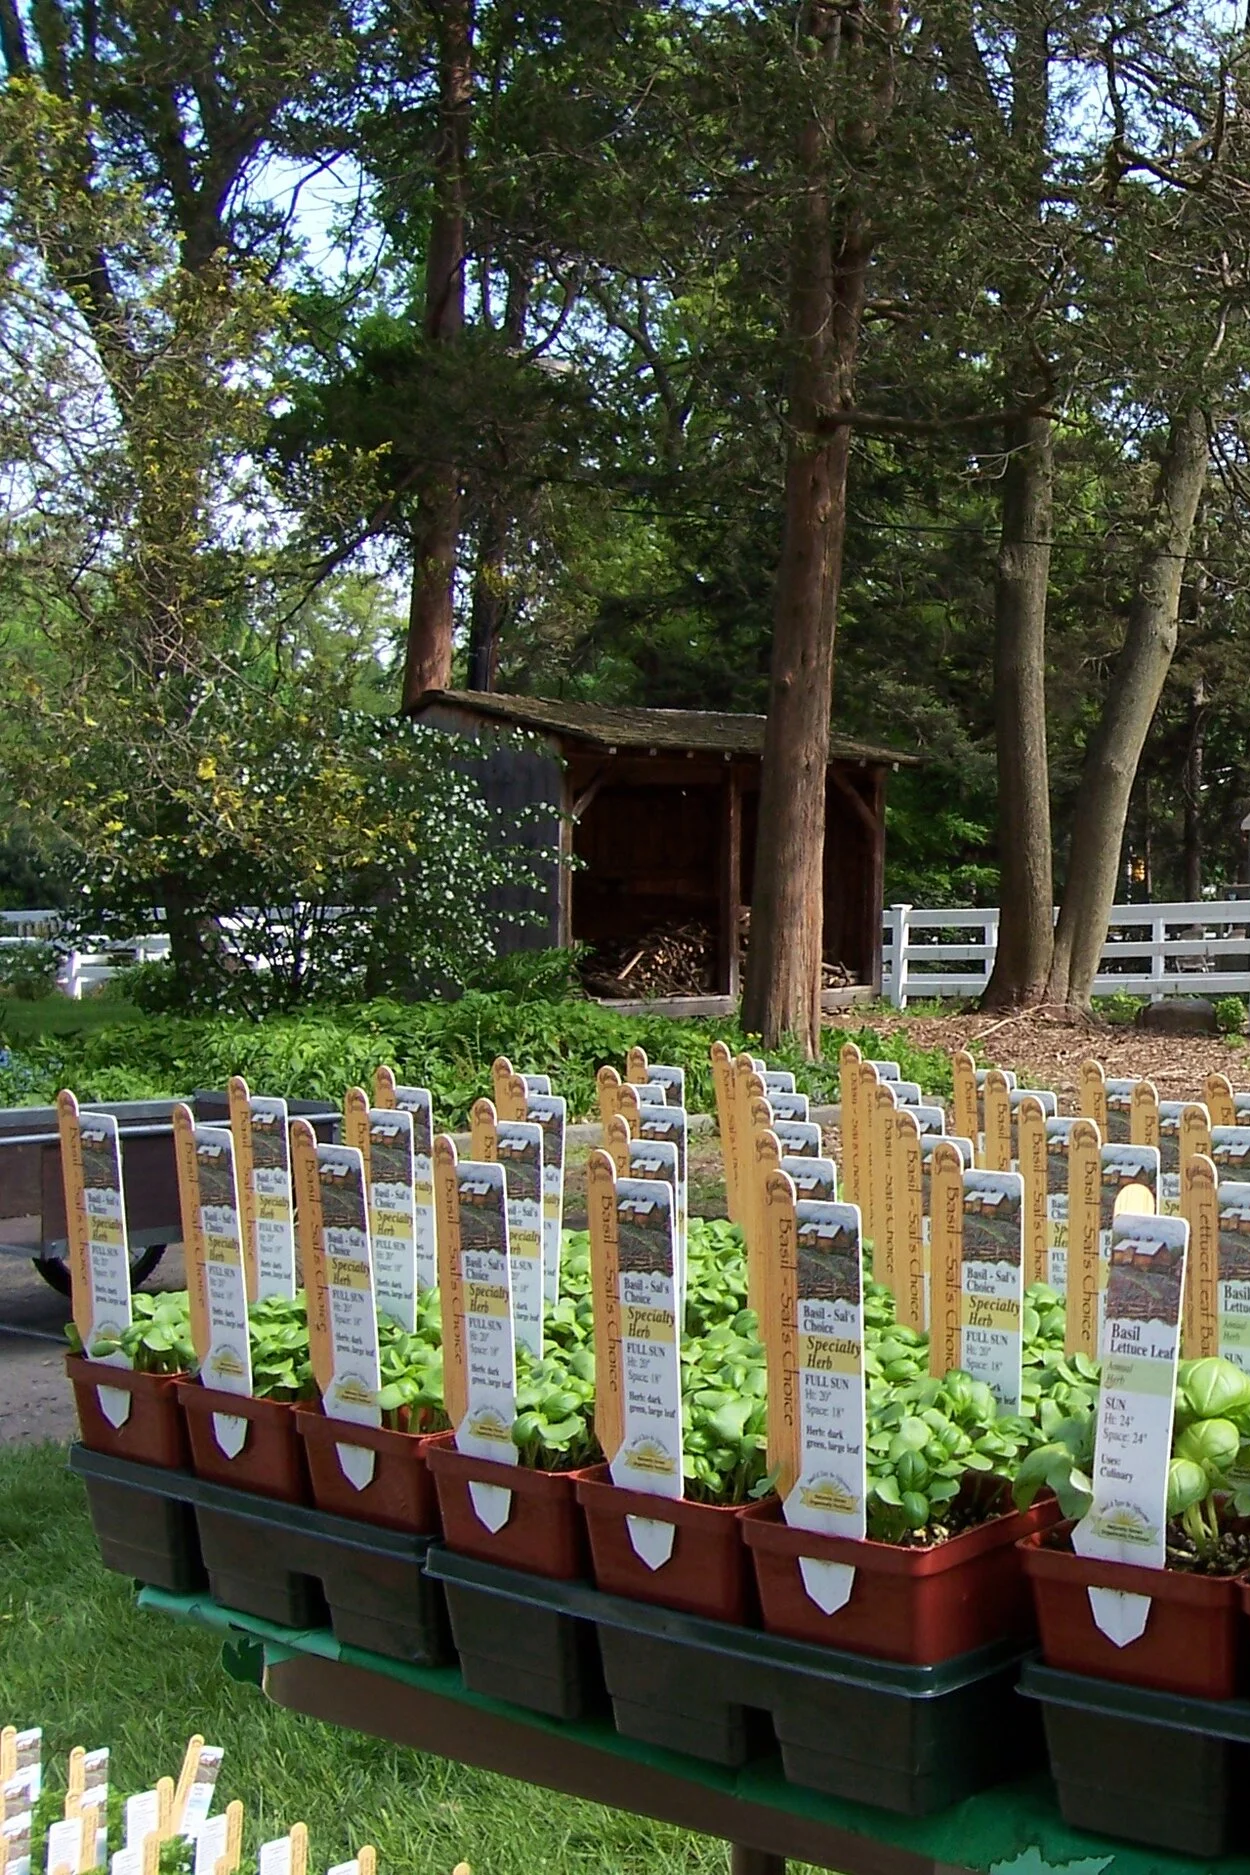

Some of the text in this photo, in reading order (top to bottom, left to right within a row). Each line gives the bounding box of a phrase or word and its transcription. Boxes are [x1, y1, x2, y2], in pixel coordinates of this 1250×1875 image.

[1032, 1133, 1047, 1174] Basil
[907, 1150, 922, 1193] Basil
[445, 1179, 460, 1224] Basil
[947, 1186, 962, 1234] Basil
[1082, 1160, 1100, 1341] Basil Sal's Choice
[466, 1255, 482, 1268] Basil
[1199, 1202, 1215, 1322] Lettuce Leaf
[466, 1268, 489, 1281] Choice
[946, 1256, 962, 1302] Sal's
[967, 1267, 1016, 1283] Basil Sal's
[469, 1283, 509, 1303] Specialty
[602, 1195, 622, 1392] Basil Sal's Choice
[624, 1277, 669, 1294] Basil Sal's
[909, 1258, 924, 1323] Choice
[967, 1280, 995, 1293] Choice
[1224, 1285, 1250, 1300] Basil
[624, 1290, 651, 1304] Choice
[969, 1296, 1020, 1314] Specialty
[470, 1298, 489, 1314] Herb
[803, 1305, 855, 1323] Basil Sal's
[627, 1306, 675, 1326] Specialty
[779, 1217, 800, 1426] Basil Sal's Choice
[969, 1312, 993, 1328] Herb
[628, 1323, 650, 1339] Herb
[803, 1319, 834, 1333] Choice
[1112, 1323, 1140, 1340] Basil
[807, 1336, 862, 1355] Specialty
[966, 1331, 1008, 1345] FULL SUN
[627, 1343, 665, 1357] FULL SUN
[1110, 1340, 1174, 1360] Lettuce Leaf
[807, 1353, 833, 1370] Herb
[805, 1375, 849, 1389] FULL SUN
[1106, 1398, 1126, 1410] SUN
[827, 1429, 843, 1440] dark
[1102, 1454, 1121, 1465] Uses:
[1100, 1467, 1133, 1483] Culinary
